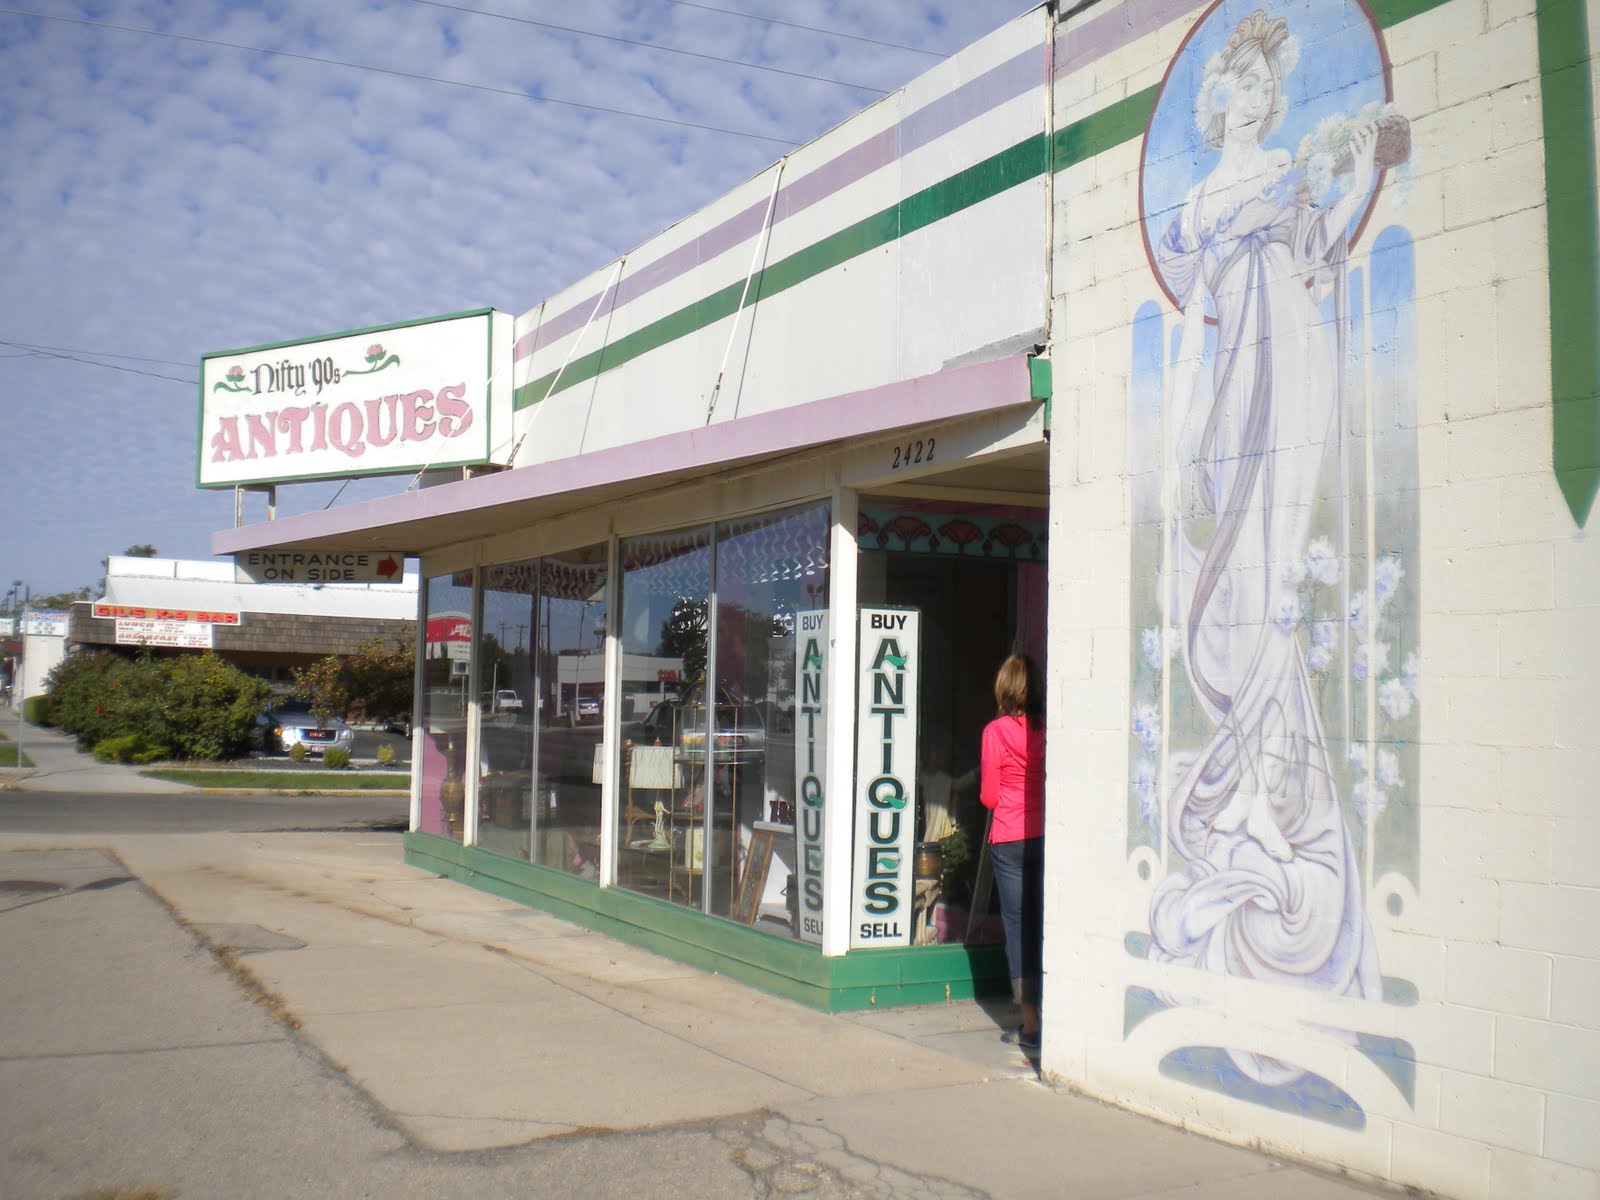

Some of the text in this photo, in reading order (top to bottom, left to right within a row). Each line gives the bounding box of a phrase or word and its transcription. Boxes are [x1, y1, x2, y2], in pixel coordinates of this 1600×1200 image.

[250, 360, 306, 396] Nifty
[211, 382, 474, 463] ANTIQUES
[892, 438, 935, 469] 2422
[248, 553, 369, 567] ENTRANCE
[264, 568, 355, 580] ON SIDE
[96, 605, 238, 623] GIL'S K-9 BAR
[803, 615, 824, 630] BUY
[871, 614, 907, 631] BUY
[802, 638, 824, 912] ANTIQUES
[864, 637, 908, 915] ANTIQUES
[860, 922, 902, 939] SELL
